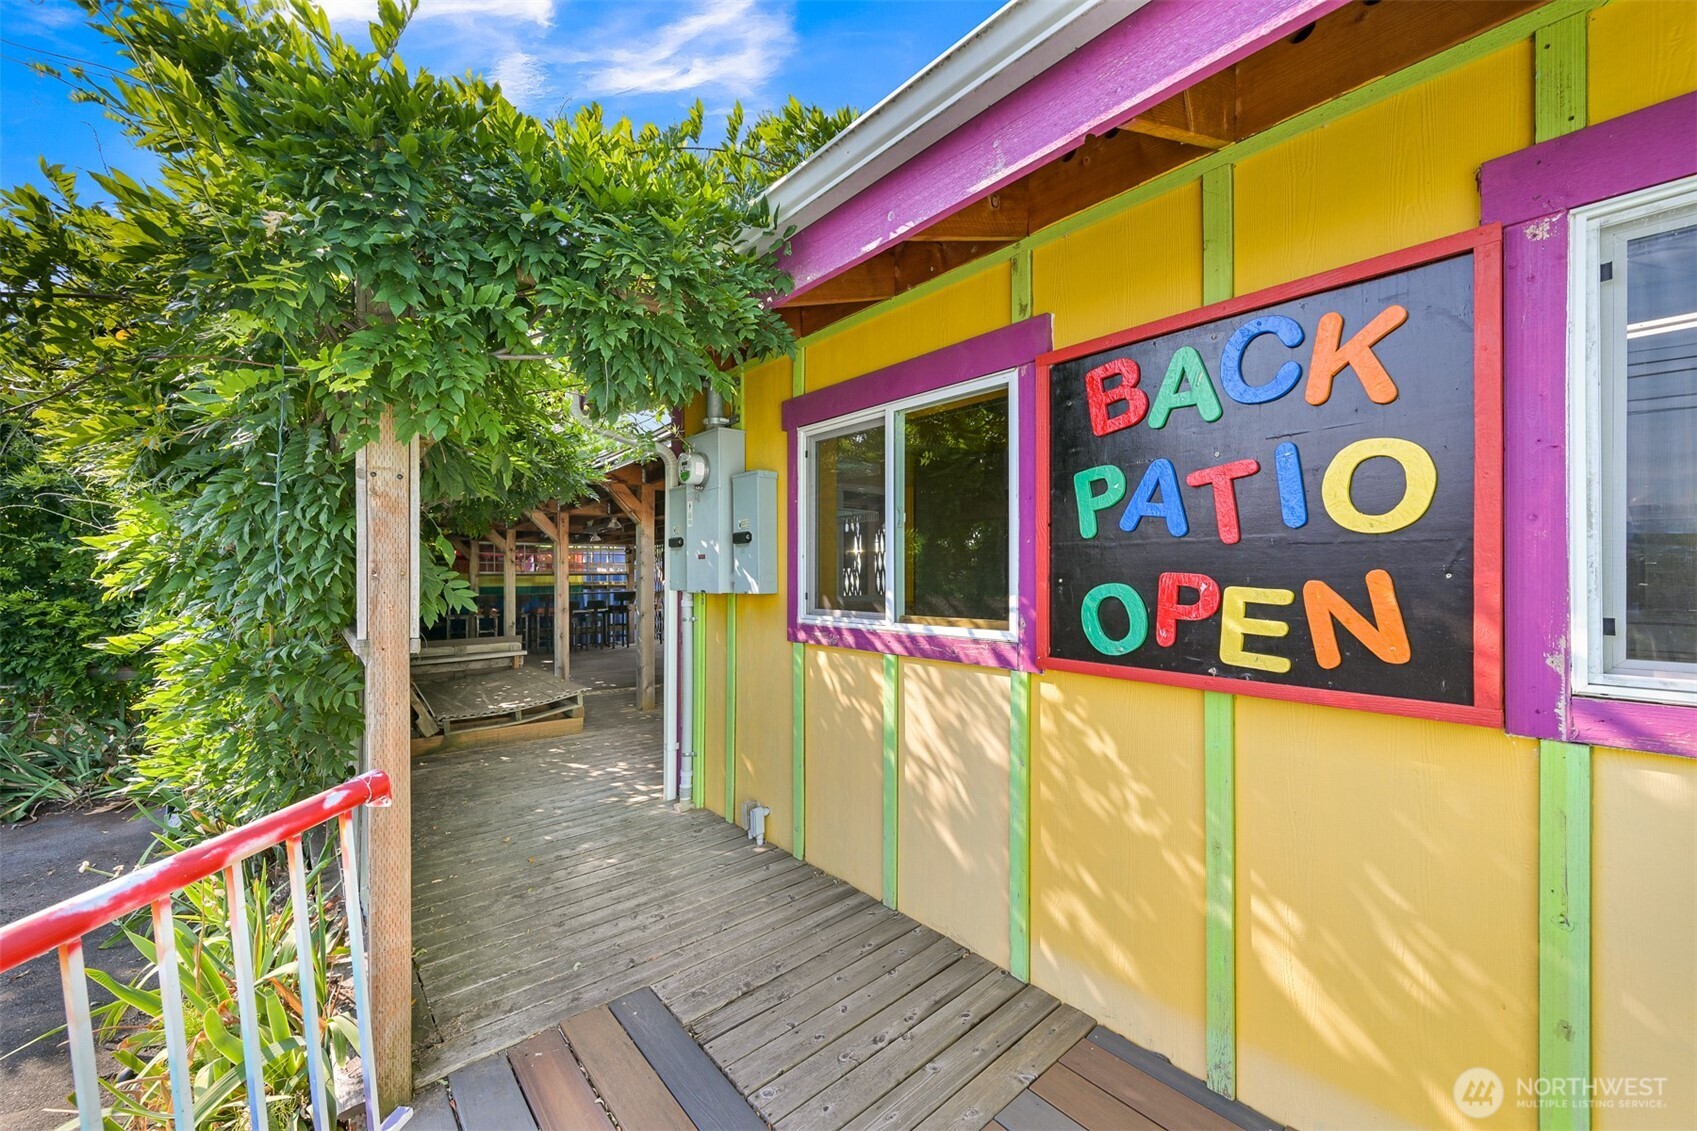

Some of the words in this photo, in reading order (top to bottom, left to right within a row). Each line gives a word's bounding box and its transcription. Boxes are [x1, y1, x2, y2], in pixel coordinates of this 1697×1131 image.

[1085, 305, 1409, 437] BACK
[1073, 437, 1438, 545] PATIO
[1081, 569, 1412, 674] OPEN
